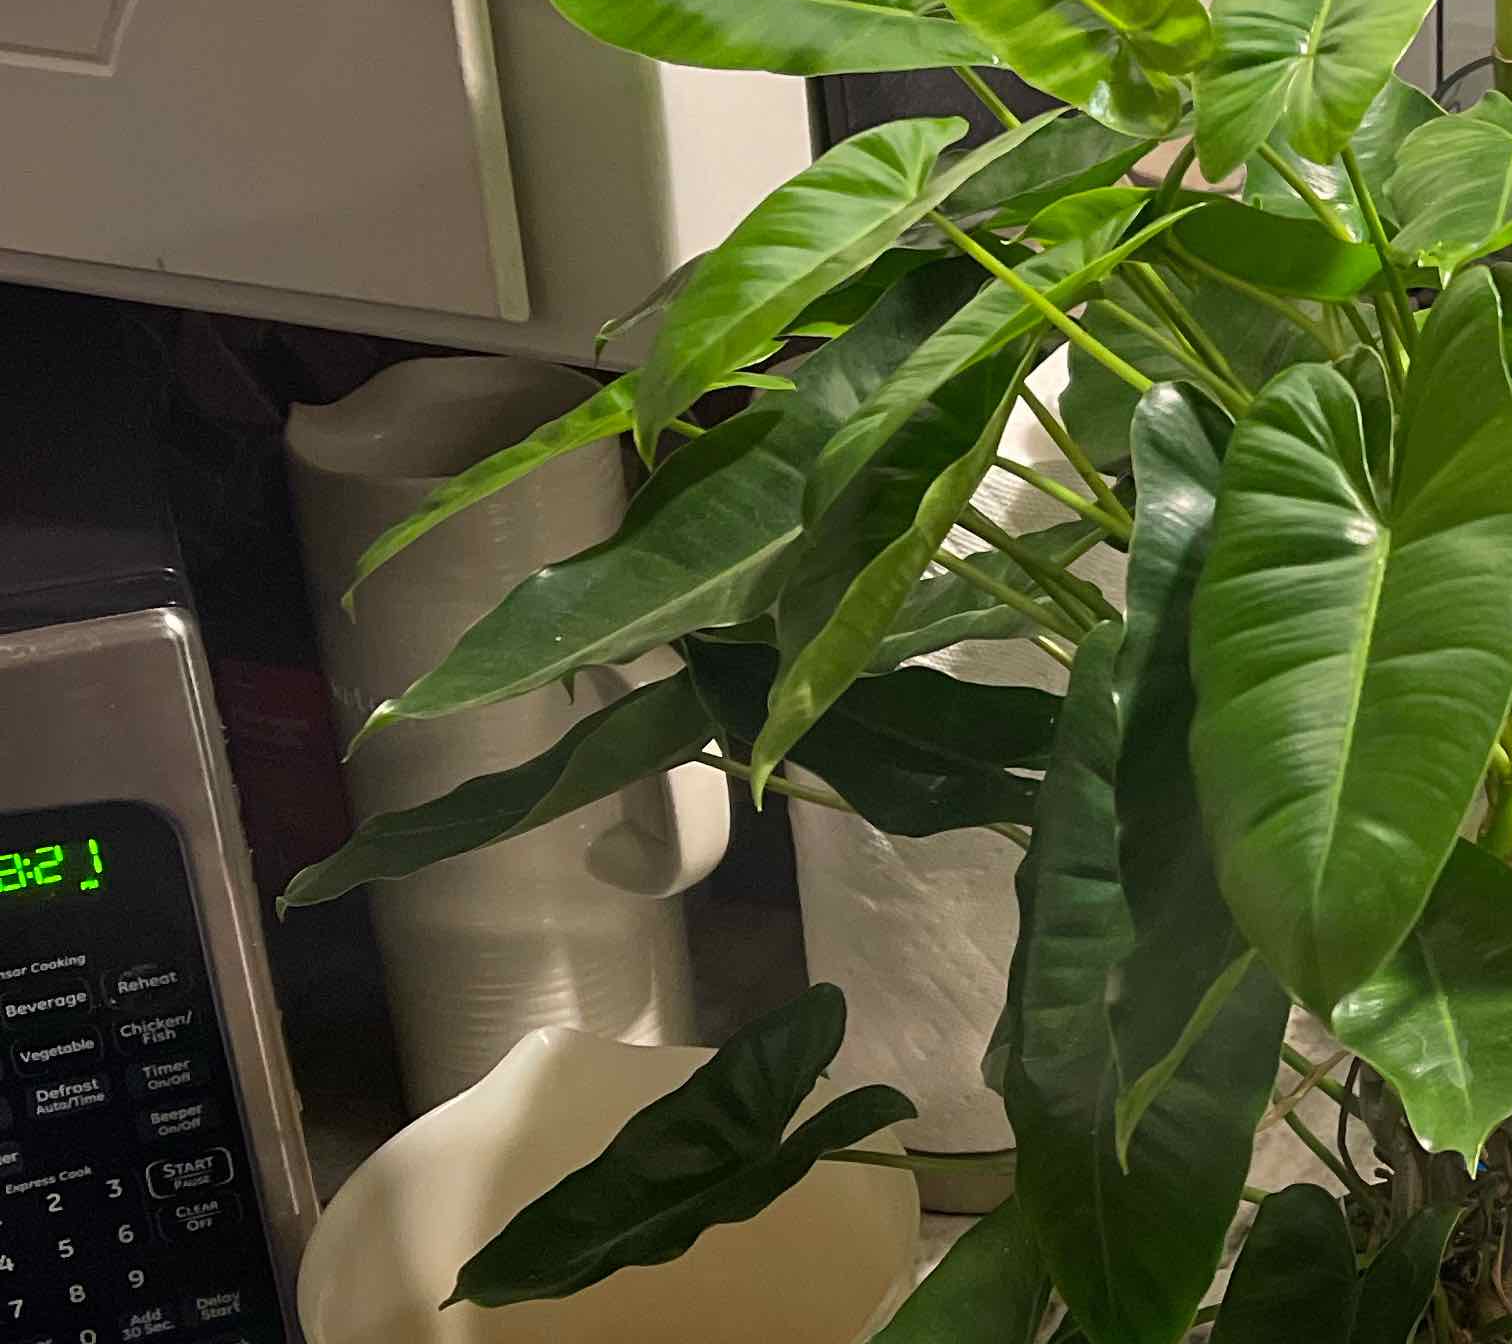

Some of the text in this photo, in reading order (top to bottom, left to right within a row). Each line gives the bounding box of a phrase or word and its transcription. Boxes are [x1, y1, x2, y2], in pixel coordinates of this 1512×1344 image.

[31, 955, 86, 973] Cooking
[118, 971, 178, 994] Reheat
[6, 992, 87, 1017] Beverage
[120, 1010, 192, 1037] Chicken/
[143, 1029, 177, 1045] Fish
[20, 1038, 95, 1063] Vegetable
[143, 1060, 191, 1078] Timer
[36, 1078, 99, 1103] Defrost
[148, 1072, 191, 1090] On/Off
[36, 1091, 105, 1115] Auto/Time
[151, 1104, 203, 1125] Beeper
[159, 1117, 202, 1136] On/Off
[163, 1156, 214, 1178] START
[6, 1166, 92, 1194] Express Cook
[105, 1178, 123, 1198] 3
[46, 1193, 63, 1212] 2
[118, 1224, 134, 1244] 6
[58, 1238, 75, 1258] 5
[128, 1269, 145, 1289] 9
[69, 1284, 86, 1303] 8
[196, 1291, 240, 1310] Delay
[8, 1299, 23, 1319] 7
[130, 1308, 163, 1327] Add
[201, 1305, 240, 1321] Start
[122, 1326, 142, 1341] 30
